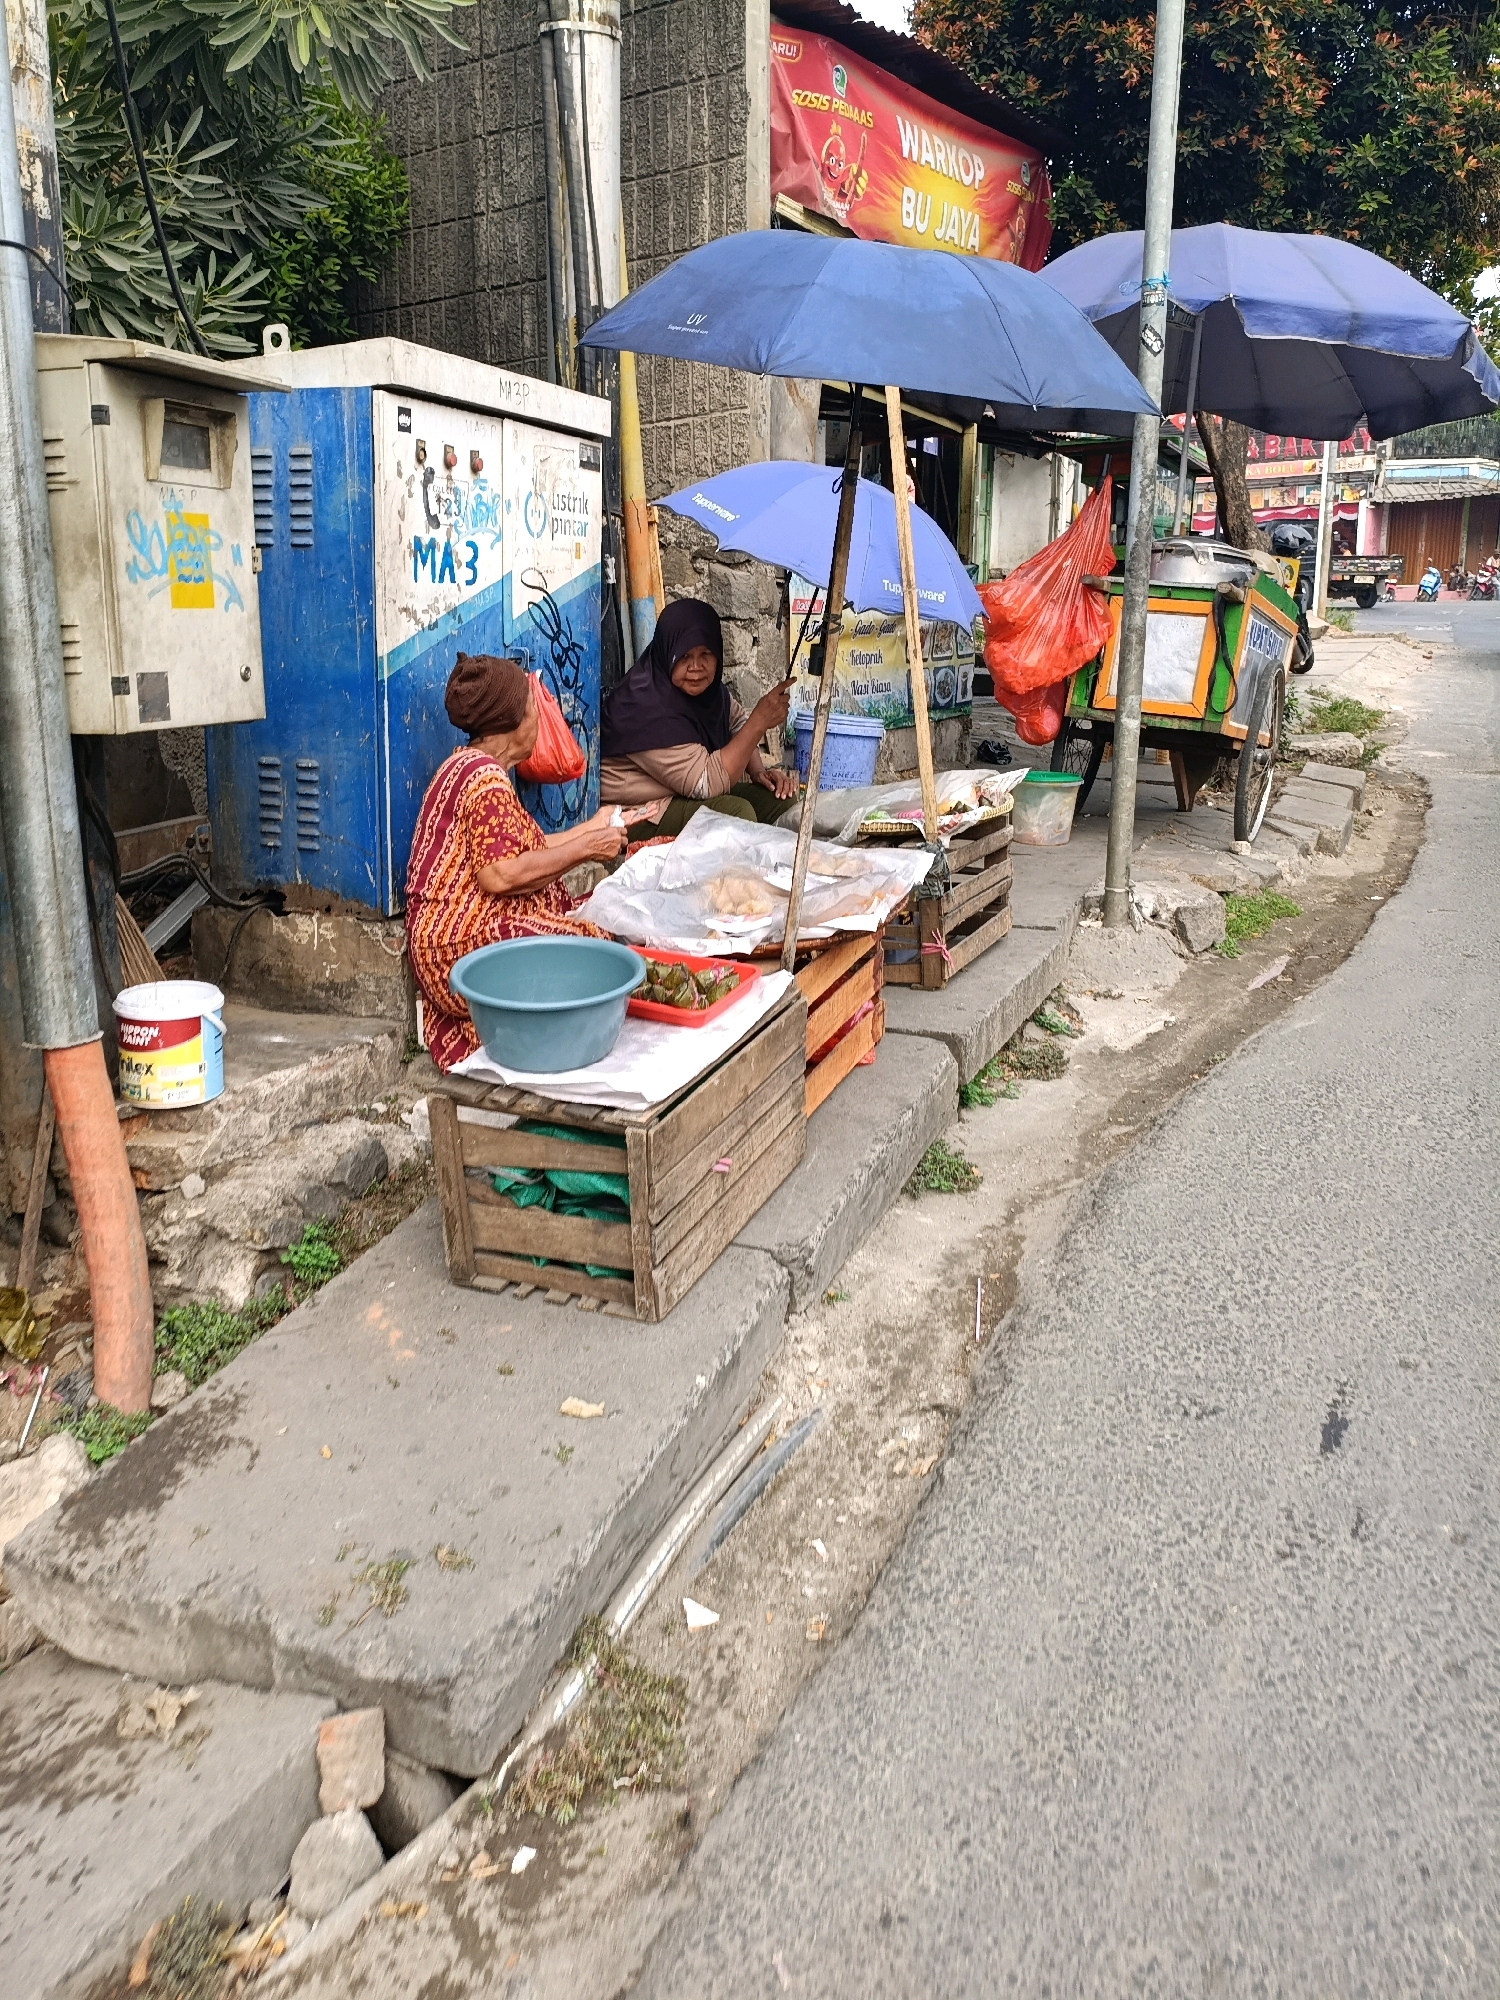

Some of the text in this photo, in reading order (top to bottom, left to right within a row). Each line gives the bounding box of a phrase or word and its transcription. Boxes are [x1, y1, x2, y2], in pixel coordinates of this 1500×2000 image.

[770, 40, 797, 57] ARU!
[791, 89, 831, 112] SOSIS
[896, 114, 985, 191] WARKOP
[902, 186, 932, 234] BU
[934, 201, 980, 253] JAYA
[687, 312, 708, 326] UV
[1264, 428, 1372, 460] BAKRY
[691, 492, 736, 522] Tupperware
[882, 579, 946, 603] Tupware
[850, 649, 883, 669] Ketoprak
[851, 680, 869, 696] Nasi
[120, 1022, 160, 1038] NIPPON
[122, 1033, 152, 1047] PAINT
